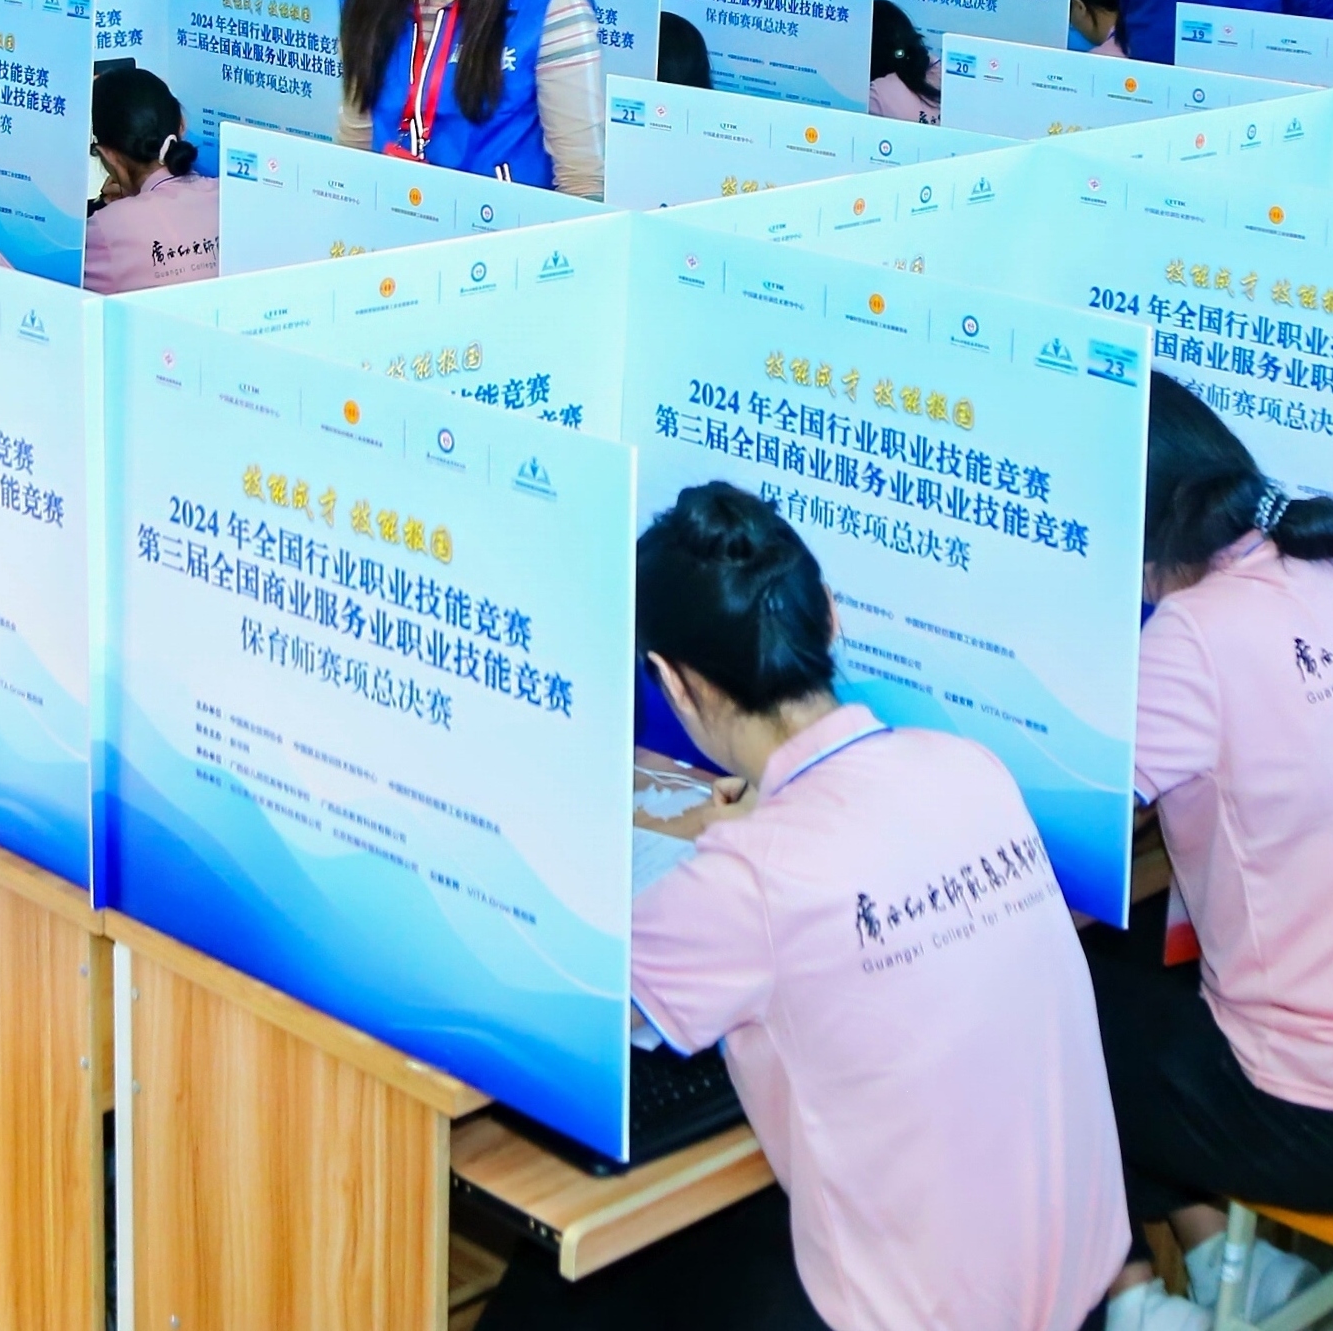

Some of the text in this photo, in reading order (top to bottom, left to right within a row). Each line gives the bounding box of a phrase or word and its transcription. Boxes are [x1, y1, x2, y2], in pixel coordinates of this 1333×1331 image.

[74, 5, 85, 16] 03
[190, 11, 214, 30] 2024
[1191, 29, 1205, 40] 19
[221, 63, 313, 100] 保育师赛项总决赛
[956, 61, 969, 74] 20
[622, 108, 637, 121] 21
[237, 162, 250, 176] 22
[154, 262, 216, 278] Guangxi College
[1089, 286, 1141, 317] 2024
[1105, 358, 1125, 378] 23
[450, 373, 553, 410] 能竞赛
[688, 378, 1051, 505] 2024 年全国行业职业技能竞赛
[655, 403, 1090, 560] 第三届全国商业服务业职业技能竞赛
[168, 495, 532, 655] 2024 年全国行业职业技能竞赛
[137, 521, 574, 720] 第三届全国商业服务业职业技能竞赛
[241, 615, 452, 732] 保育师赛项总决赛
[862, 942, 925, 974] Guangxi
[932, 921, 977, 949] College
[982, 912, 999, 926] for
